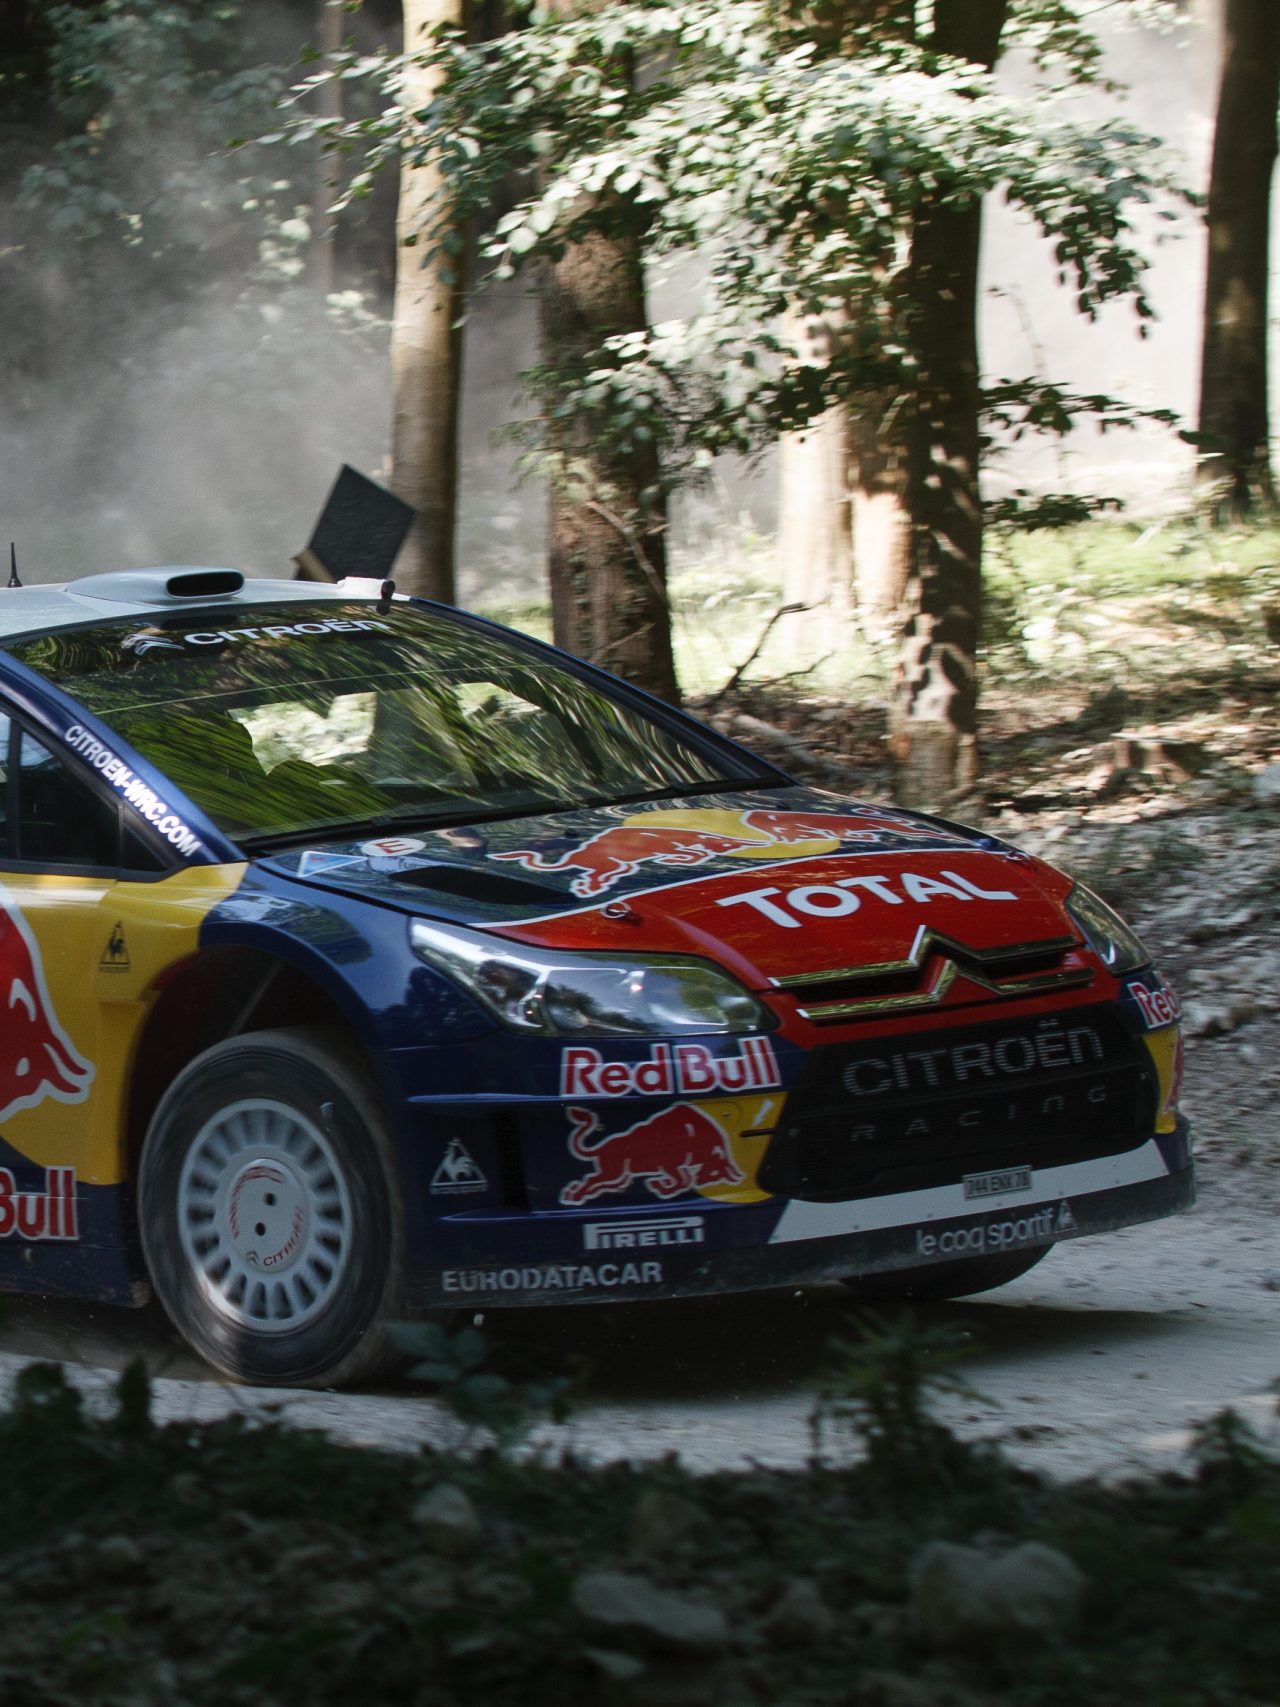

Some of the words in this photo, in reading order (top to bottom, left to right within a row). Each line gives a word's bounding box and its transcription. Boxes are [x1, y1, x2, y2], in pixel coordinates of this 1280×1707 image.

[64, 724, 201, 858] CITROEN-WRC.COM
[717, 870, 1019, 928] TOTAL
[560, 1043, 674, 1098] Red
[674, 1036, 781, 1093] Bull
[584, 1215, 704, 1250] PIRELLI
[916, 1230, 937, 1256] le
[938, 1225, 986, 1254] coq
[987, 1206, 1053, 1251] sportif
[441, 1261, 663, 1292] EURODATACAR
